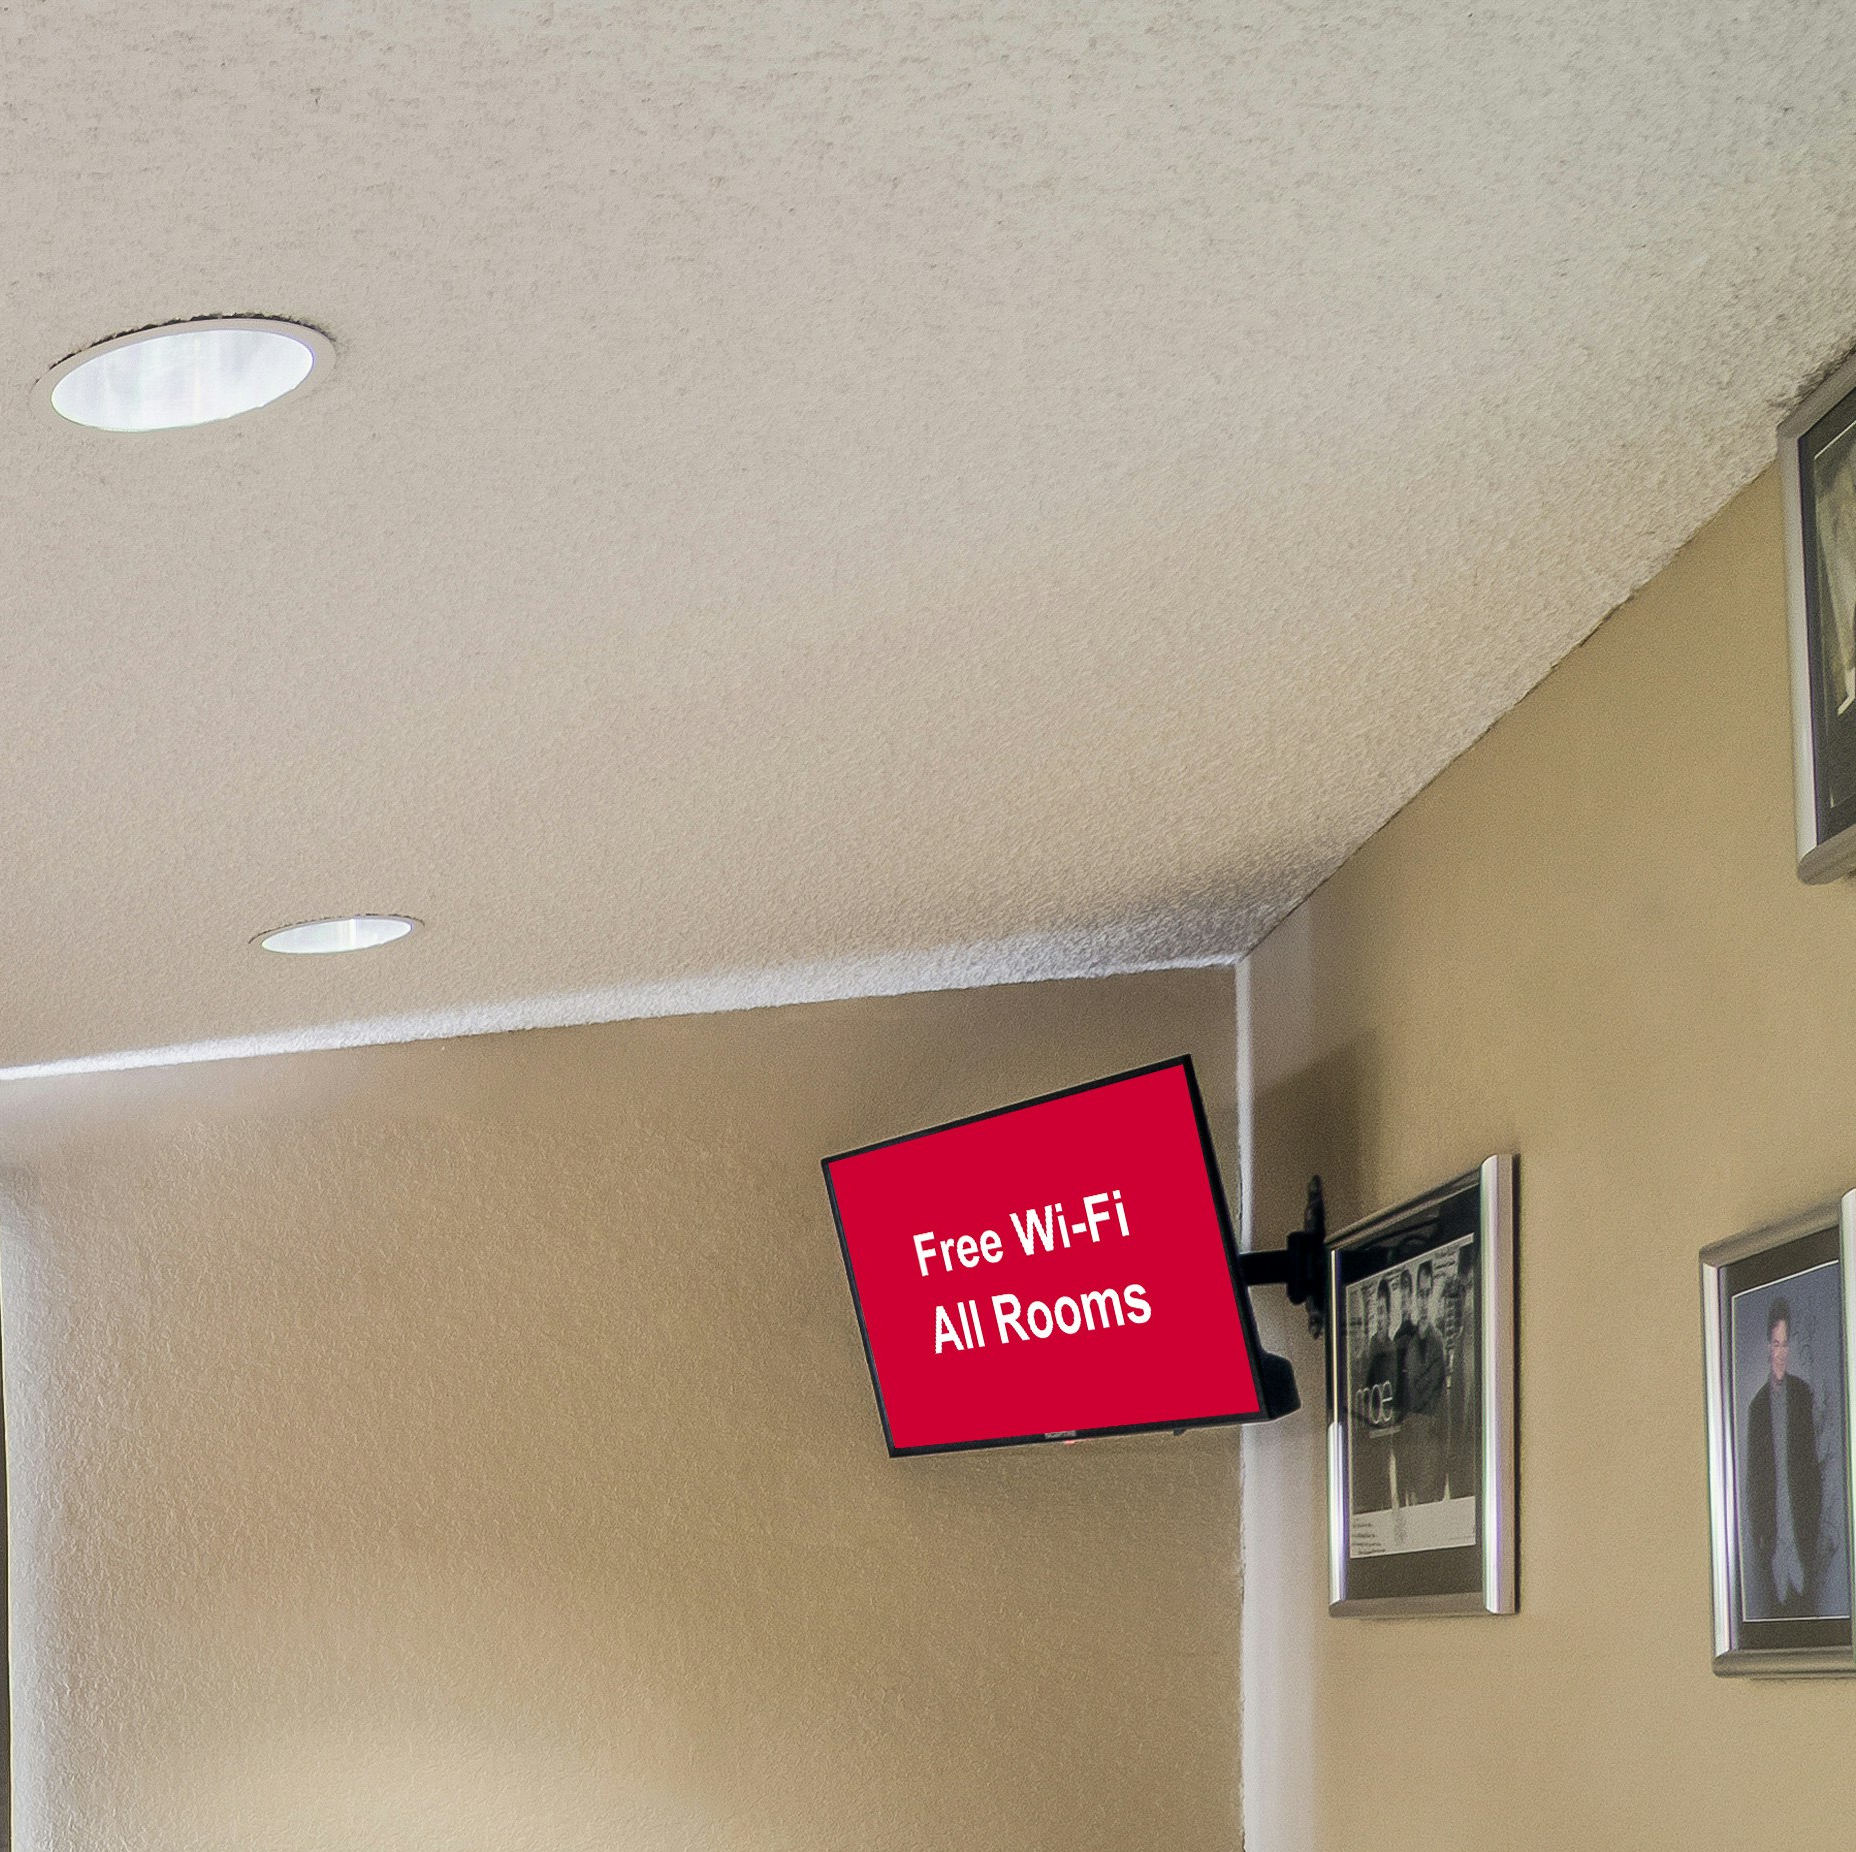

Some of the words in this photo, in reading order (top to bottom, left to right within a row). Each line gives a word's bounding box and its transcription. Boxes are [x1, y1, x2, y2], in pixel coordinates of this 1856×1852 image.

[913, 1230, 1004, 1276] Free
[1009, 1190, 1130, 1256] Wi-Fi
[935, 1300, 986, 1354] All
[992, 1284, 1152, 1344] Rooms
